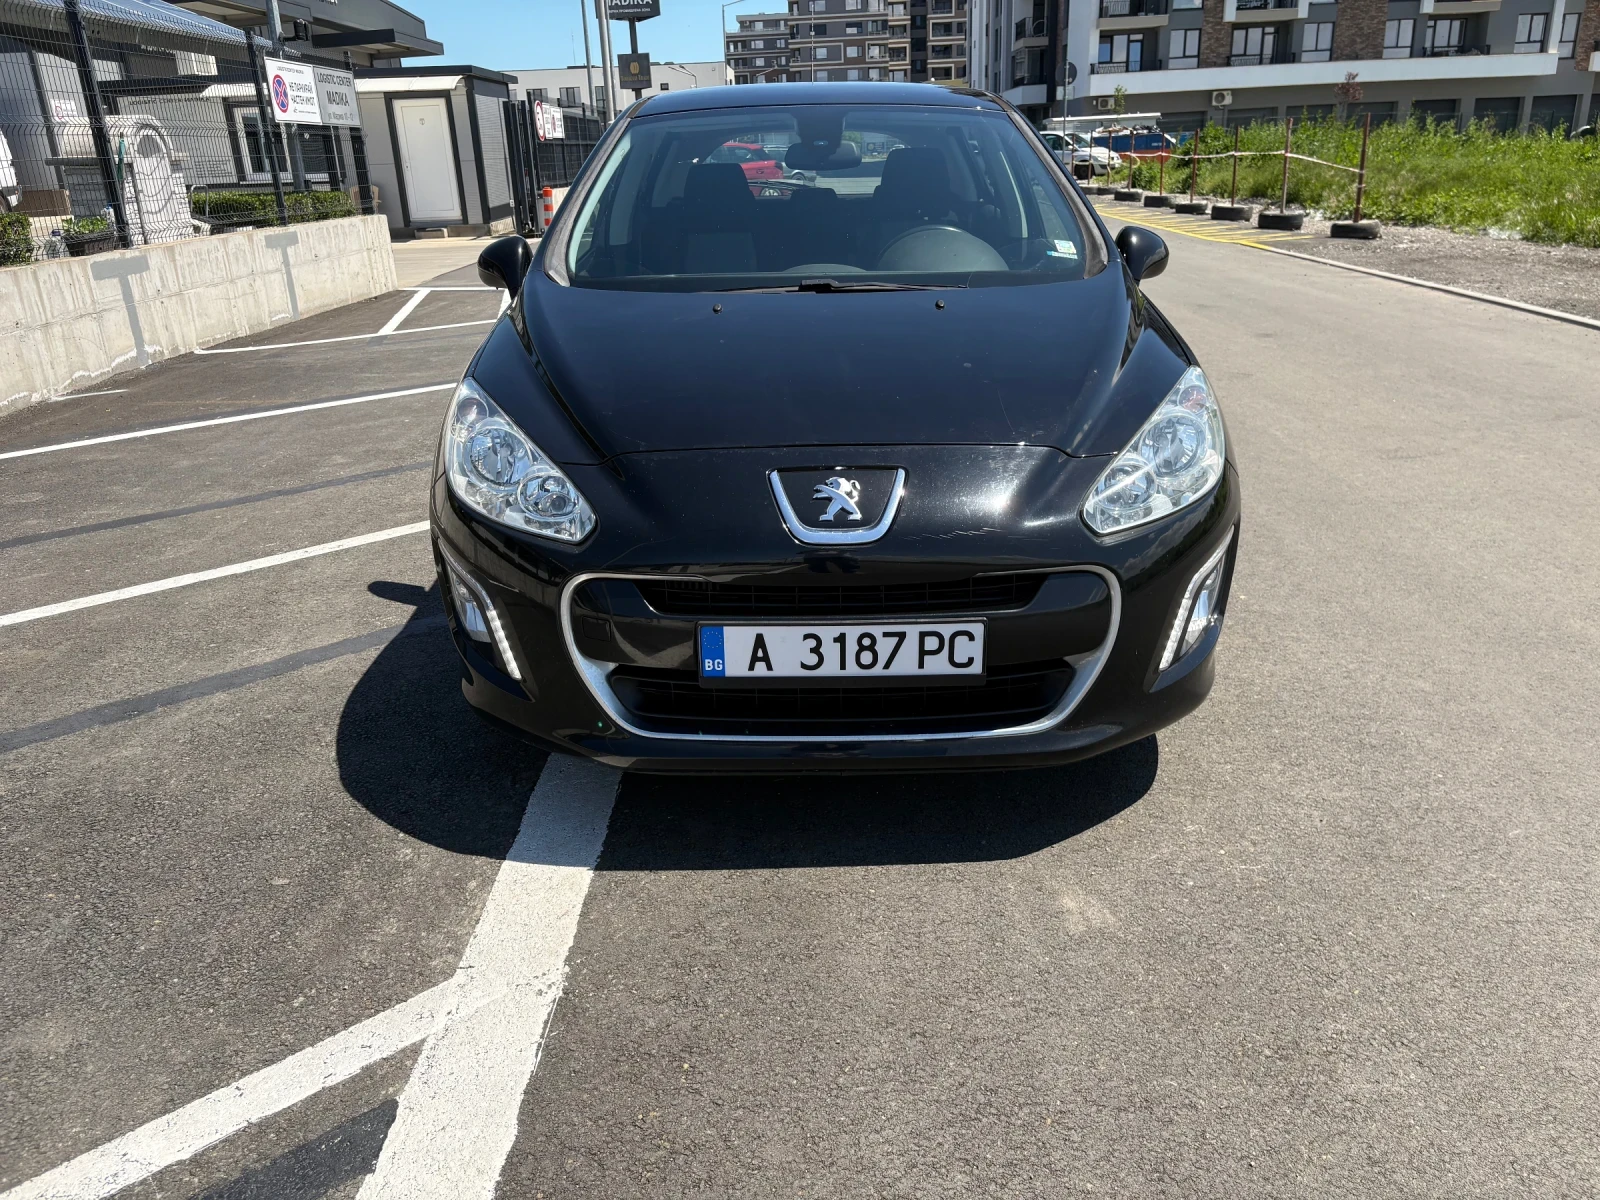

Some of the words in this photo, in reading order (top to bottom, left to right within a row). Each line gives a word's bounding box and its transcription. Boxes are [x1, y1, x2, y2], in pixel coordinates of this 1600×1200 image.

[317, 72, 337, 85] LOGISTIC
[336, 75, 352, 87] CENTER
[326, 90, 350, 107] MADIKA
[748, 633, 774, 672] A
[800, 631, 907, 671] 3187
[917, 630, 976, 670] PC
[705, 659, 723, 671] BG
